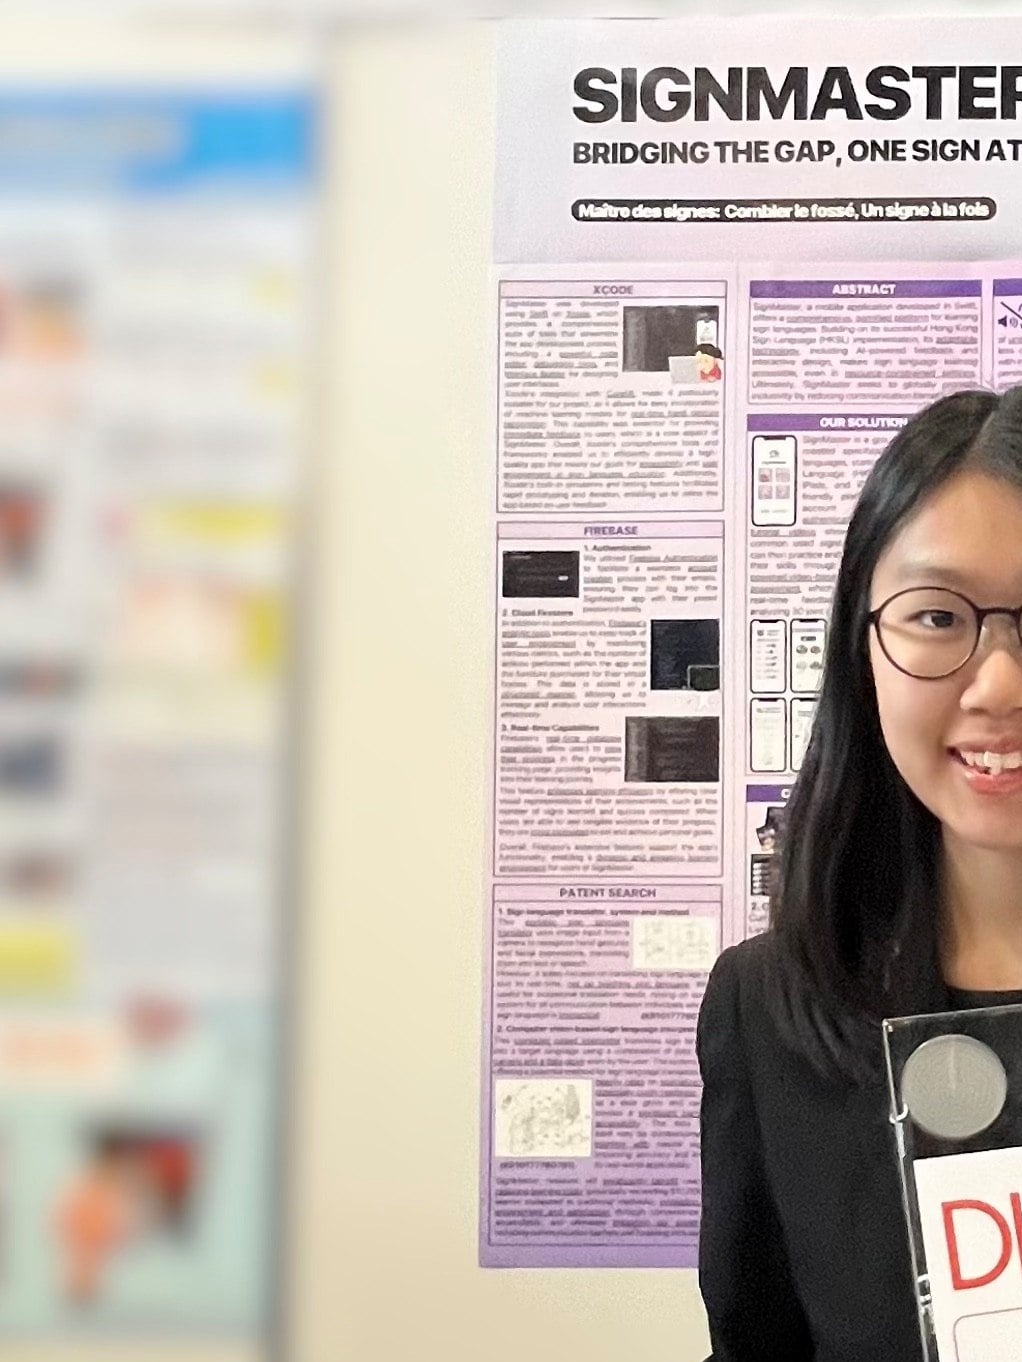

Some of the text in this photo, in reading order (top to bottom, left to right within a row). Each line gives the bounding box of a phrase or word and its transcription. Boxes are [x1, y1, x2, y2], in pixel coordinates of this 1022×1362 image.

[573, 141, 710, 165] BRIDGING
[714, 140, 769, 163] THE
[774, 140, 842, 167] GAP,
[847, 139, 906, 162] ONE
[912, 139, 981, 162] SIGN
[578, 202, 989, 220] Maître des signes: Combler le fossé, Un signe à la fois
[593, 286, 633, 295] XCODE
[832, 284, 896, 295] ABSTRACT
[819, 417, 846, 427] OUR
[584, 526, 638, 535] FIREBASE
[559, 888, 656, 897] PATENT SEARCH
